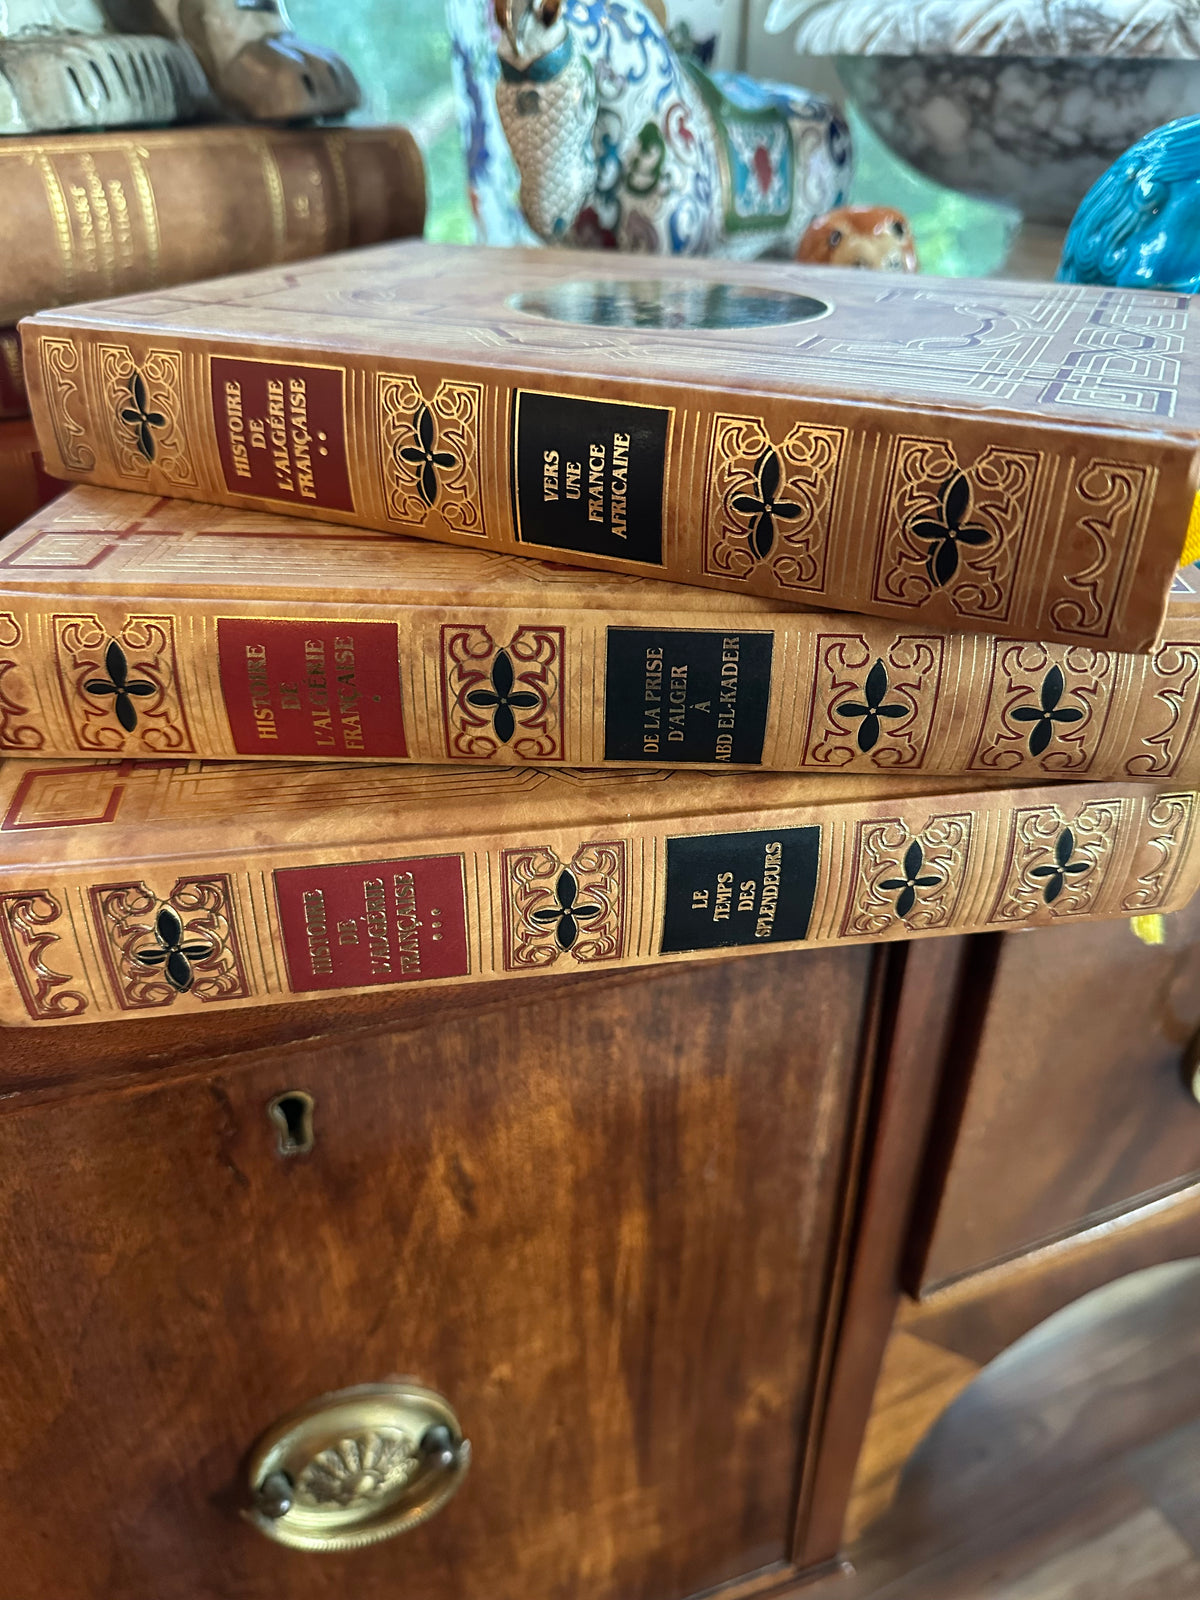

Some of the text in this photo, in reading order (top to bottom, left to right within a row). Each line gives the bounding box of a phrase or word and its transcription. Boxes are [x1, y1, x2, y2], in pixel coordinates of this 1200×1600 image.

[224, 379, 252, 478] HISTOIRE
[249, 418, 267, 450] DE
[265, 379, 294, 492] L'ALGÉRIE
[289, 378, 316, 499] FRANÇAISE
[543, 450, 560, 502] VERS
[566, 461, 581, 500] UNE
[588, 443, 606, 523] FRANCE
[611, 433, 631, 540] AFRICAINE
[245, 644, 278, 740] HISTOIRE
[279, 682, 302, 710] DE
[302, 639, 337, 746] L'ALGÉRIE
[334, 635, 365, 750] FRANÇAISE
[643, 647, 664, 753] DE LA PRISE
[668, 664, 688, 742] D'ALGER
[689, 700, 711, 713] À
[715, 733, 733, 762] ABD
[360, 877, 392, 975] L'ALGÉRIE
[393, 871, 423, 975] FRANÇAISE
[691, 889, 709, 910] LE
[712, 871, 734, 922] TEMPS
[737, 880, 756, 912] DES
[754, 841, 783, 938] SPLENDEURS
[302, 888, 333, 975] HISTOIRE
[337, 918, 359, 946] DE
